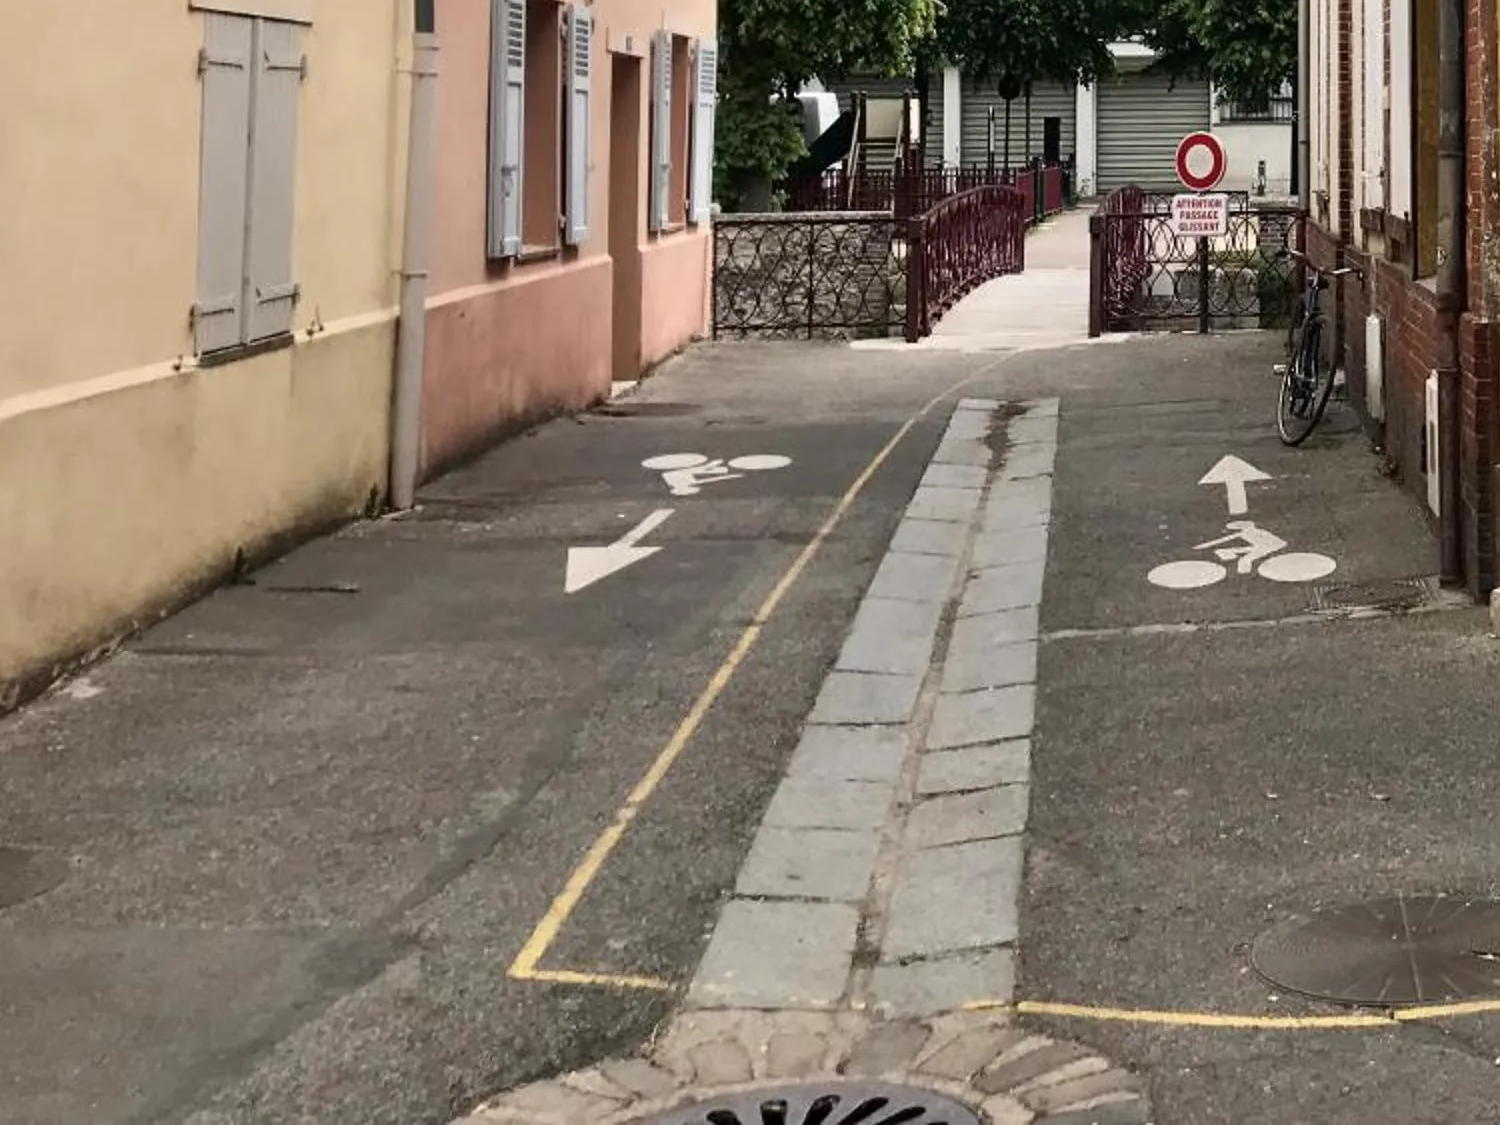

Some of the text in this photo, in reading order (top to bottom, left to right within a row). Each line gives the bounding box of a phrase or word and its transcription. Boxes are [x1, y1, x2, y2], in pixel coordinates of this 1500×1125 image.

[1176, 198, 1222, 208] ATTENTION
[1180, 210, 1218, 220] PASSAGE
[1178, 221, 1219, 231] GLISSANT
